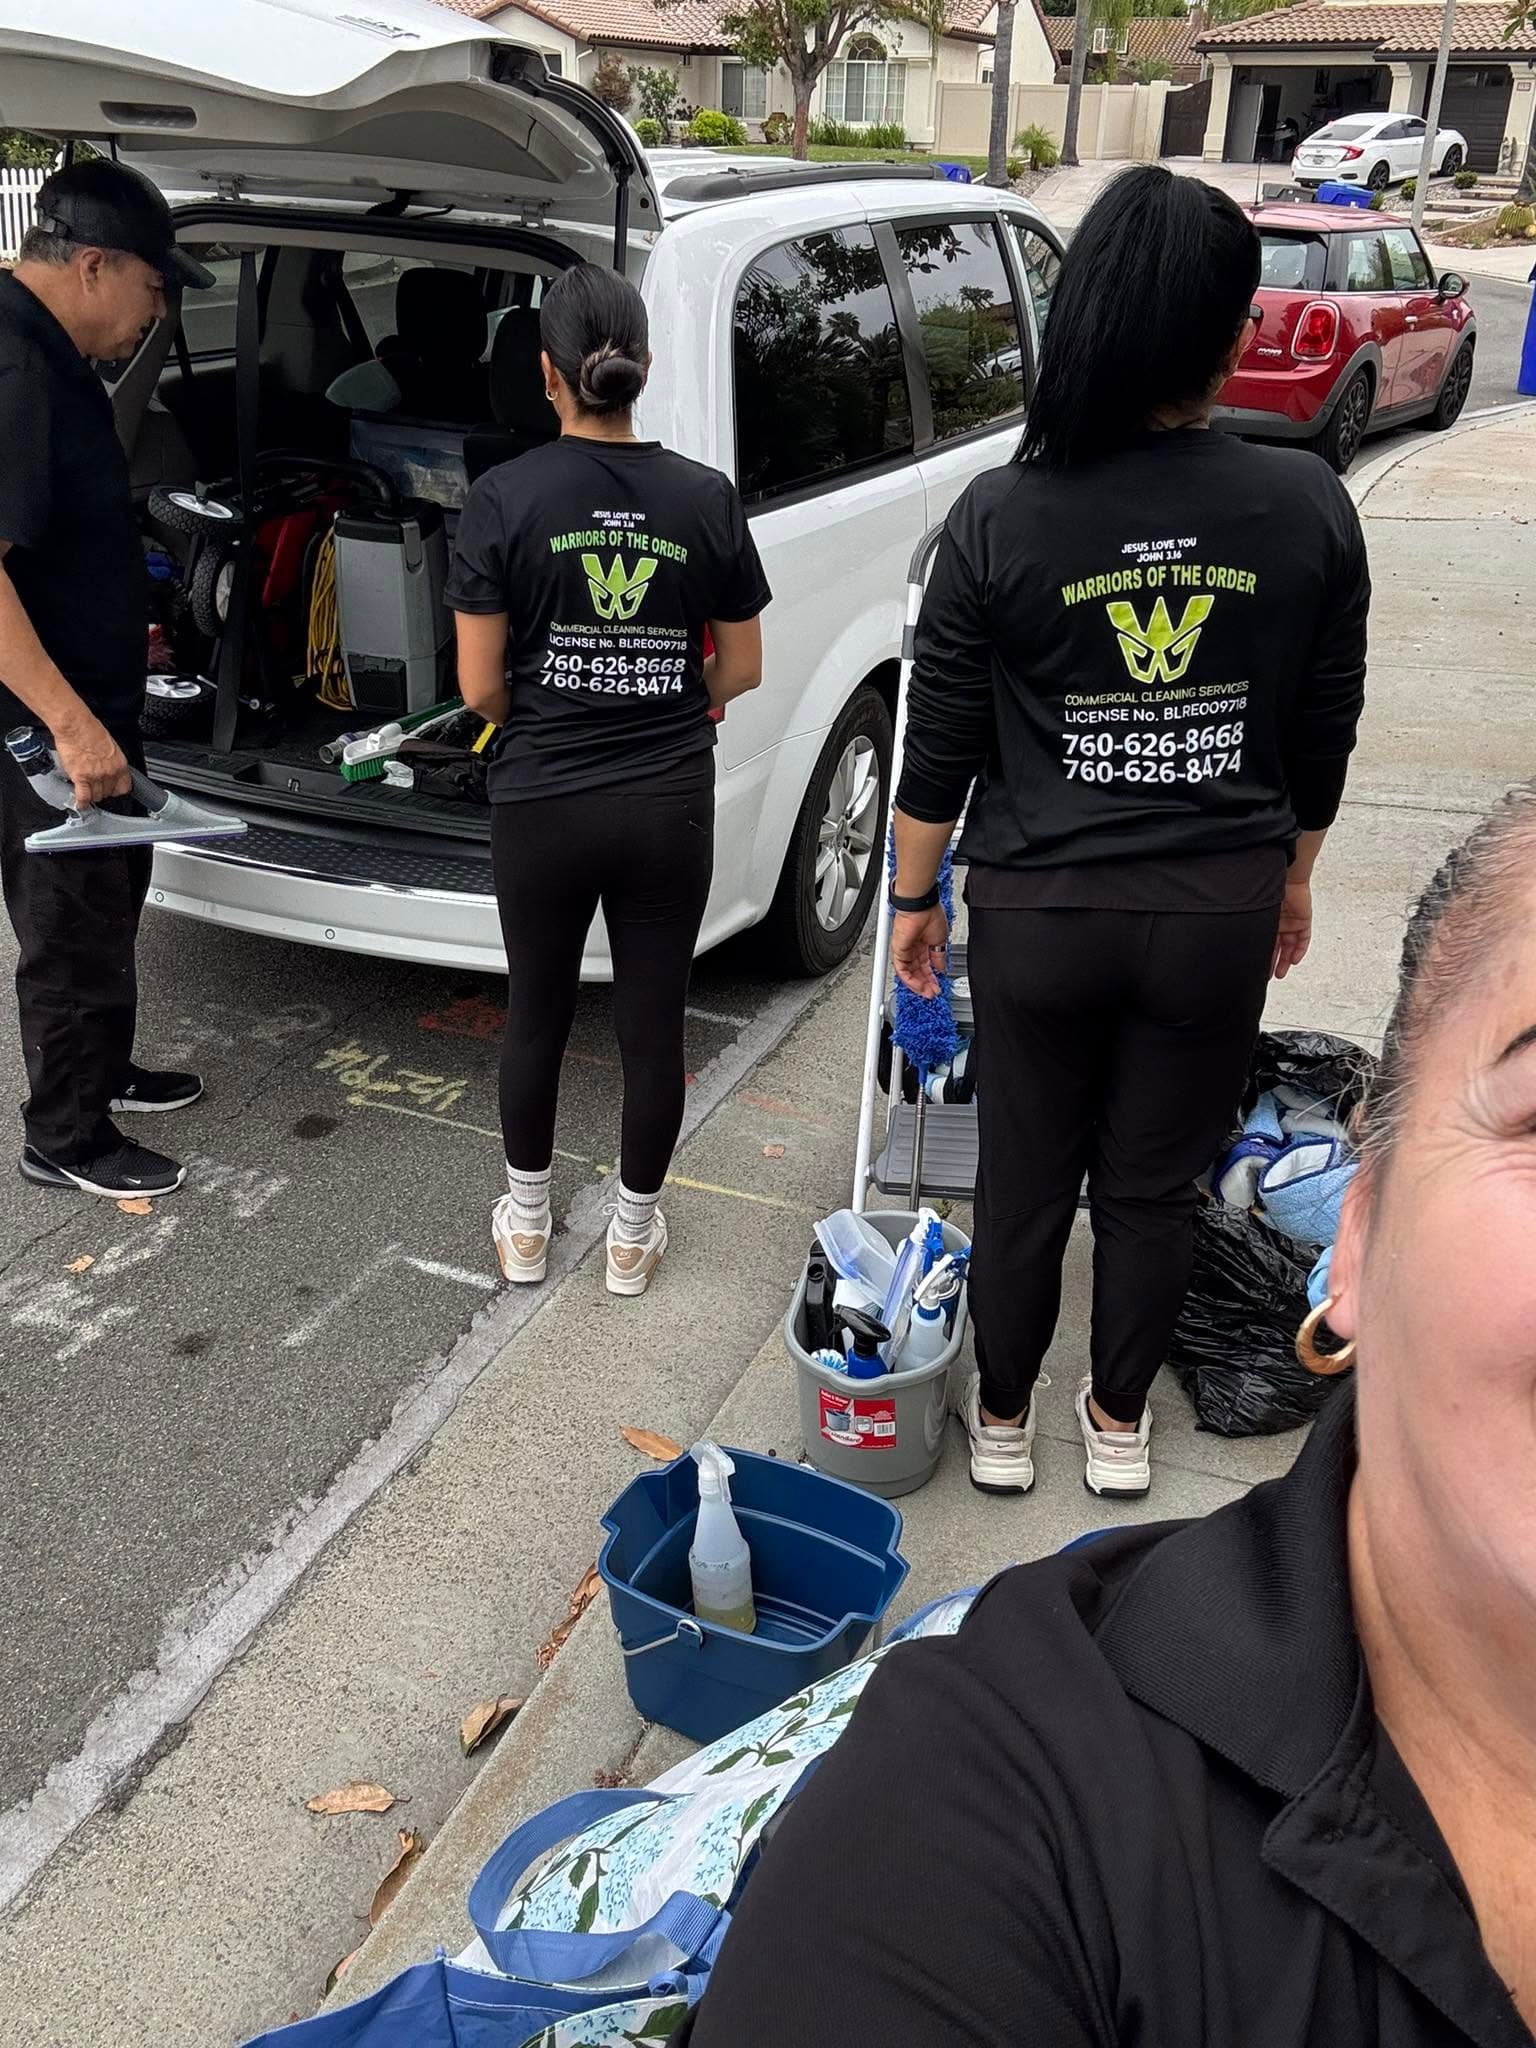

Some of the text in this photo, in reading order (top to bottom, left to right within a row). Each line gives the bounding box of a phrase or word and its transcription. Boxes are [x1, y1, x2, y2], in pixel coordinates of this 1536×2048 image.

[550, 530, 688, 564] WARRIORS OF THE ORDER
[1121, 537, 1197, 554] JESUS LOVE YOU
[1137, 552, 1163, 563] JOHN
[1062, 565, 1257, 606] WARRIORS OF THE ORDER
[549, 633, 597, 649] LICENSE
[599, 638, 616, 648] No.
[550, 621, 688, 638] COMMERCIAL CLEANING SERVICES
[543, 650, 687, 676] 760-626-8668
[540, 669, 683, 696] 760-626-8474
[1065, 681, 1249, 706] COMMERCIAL CLEANING SERVICES
[1065, 709, 1129, 724] LICENSE
[1133, 710, 1159, 723] No.
[1062, 721, 1244, 758] 760-626-8668
[1062, 749, 1242, 784] 760-626-8474
